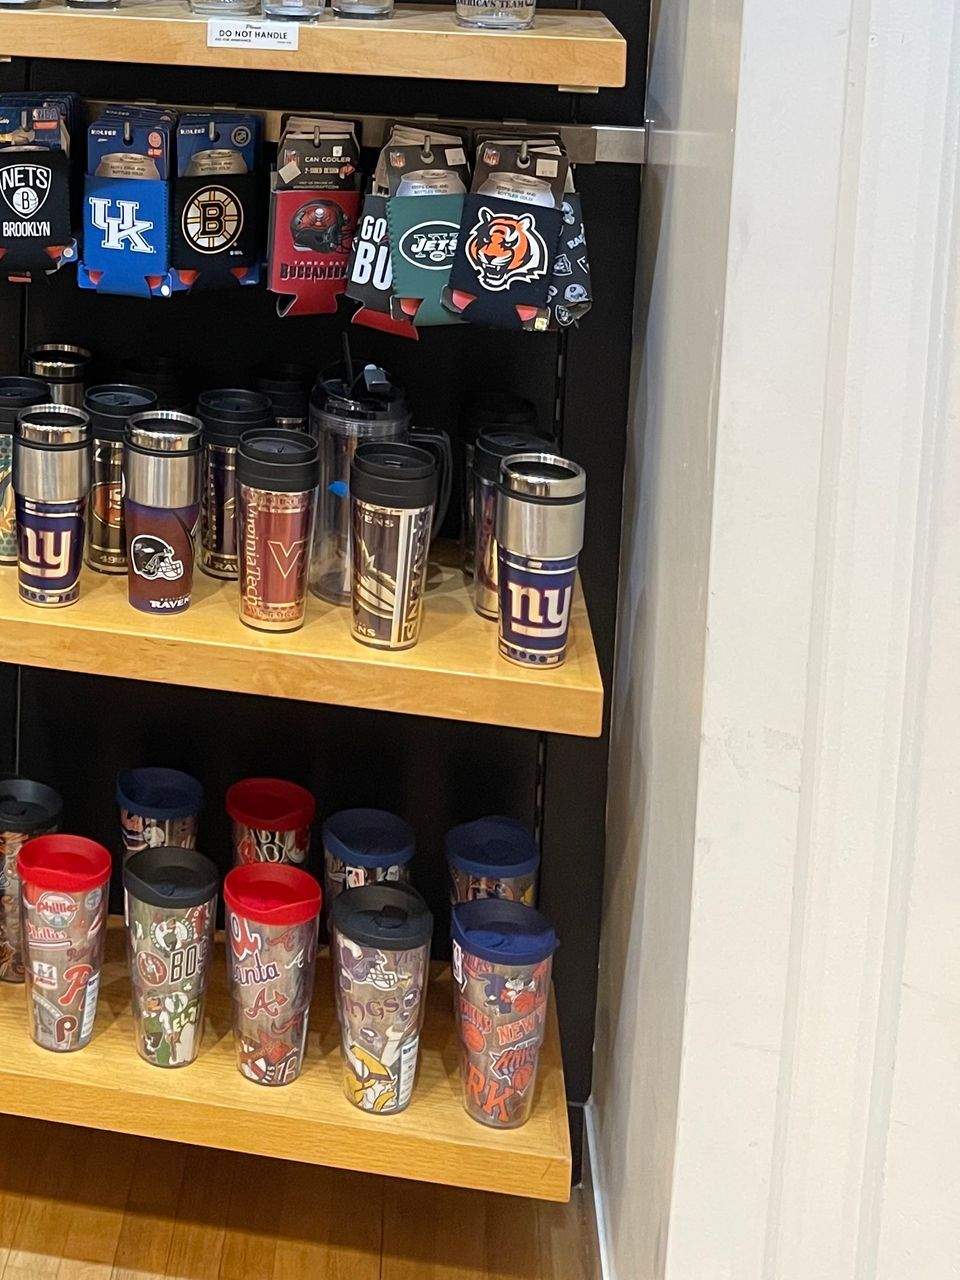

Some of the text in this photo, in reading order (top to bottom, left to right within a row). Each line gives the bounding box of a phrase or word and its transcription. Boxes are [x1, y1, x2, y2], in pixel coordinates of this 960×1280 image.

[235, 30, 252, 38] NOT
[254, 31, 287, 39] HANDLE
[1, 166, 48, 190] NETS
[20, 191, 30, 211] B
[3, 221, 50, 237] BROOKLYN
[89, 197, 154, 254] UK
[198, 201, 233, 237] B
[411, 231, 457, 254] JETS
[19, 527, 71, 579] ny
[150, 598, 192, 610] RAVEN
[508, 582, 573, 639] ny
[37, 902, 80, 914] Phillies
[169, 943, 198, 984] BO
[284, 948, 305, 969] A
[245, 987, 289, 1020] A
[497, 1018, 536, 1046] NEW
